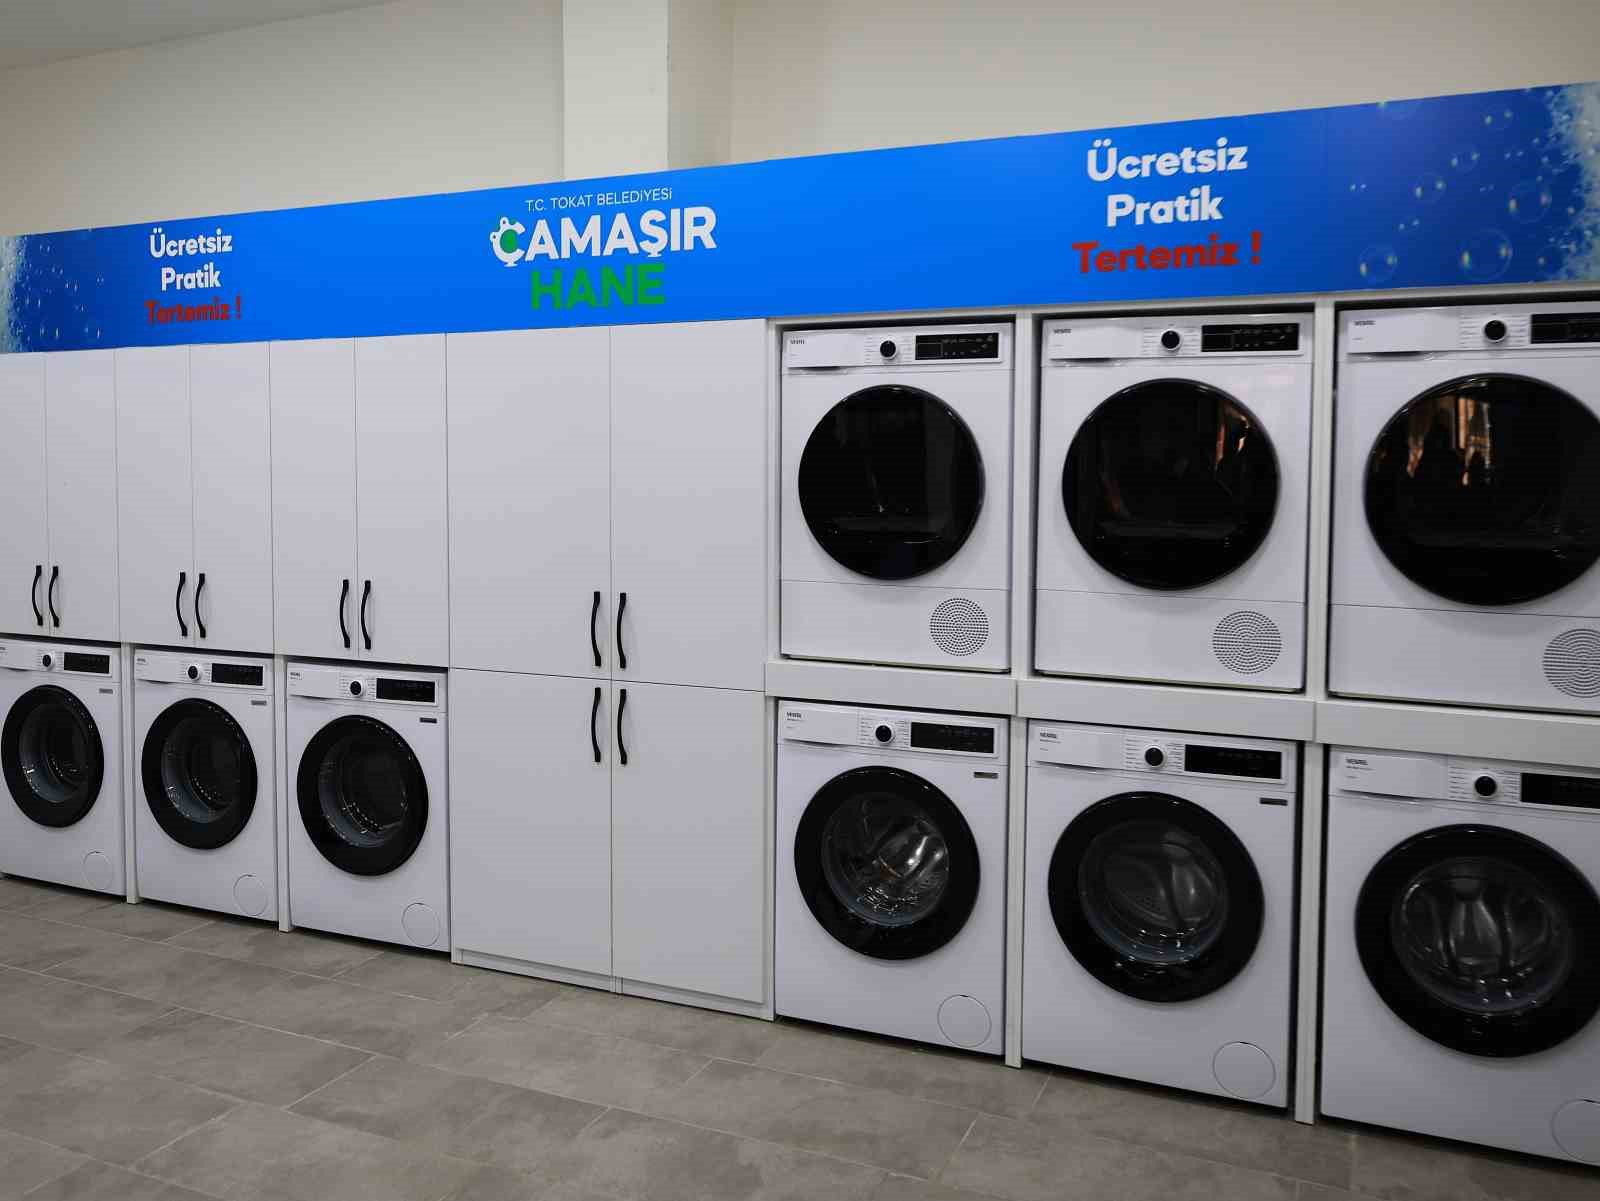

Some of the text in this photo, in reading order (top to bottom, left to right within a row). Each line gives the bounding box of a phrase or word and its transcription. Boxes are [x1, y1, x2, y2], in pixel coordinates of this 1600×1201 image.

[1087, 137, 1248, 182] Ücretsiz
[550, 194, 593, 209] TOKAT
[1107, 185, 1223, 227] Pratik
[149, 227, 233, 258] Ücretsiz
[489, 206, 717, 267] ÇAMAŞIR
[1072, 231, 1240, 274] Tertemiz
[161, 262, 221, 291] Pratik
[531, 263, 667, 310] HANE
[144, 296, 230, 325] Tertemiz
